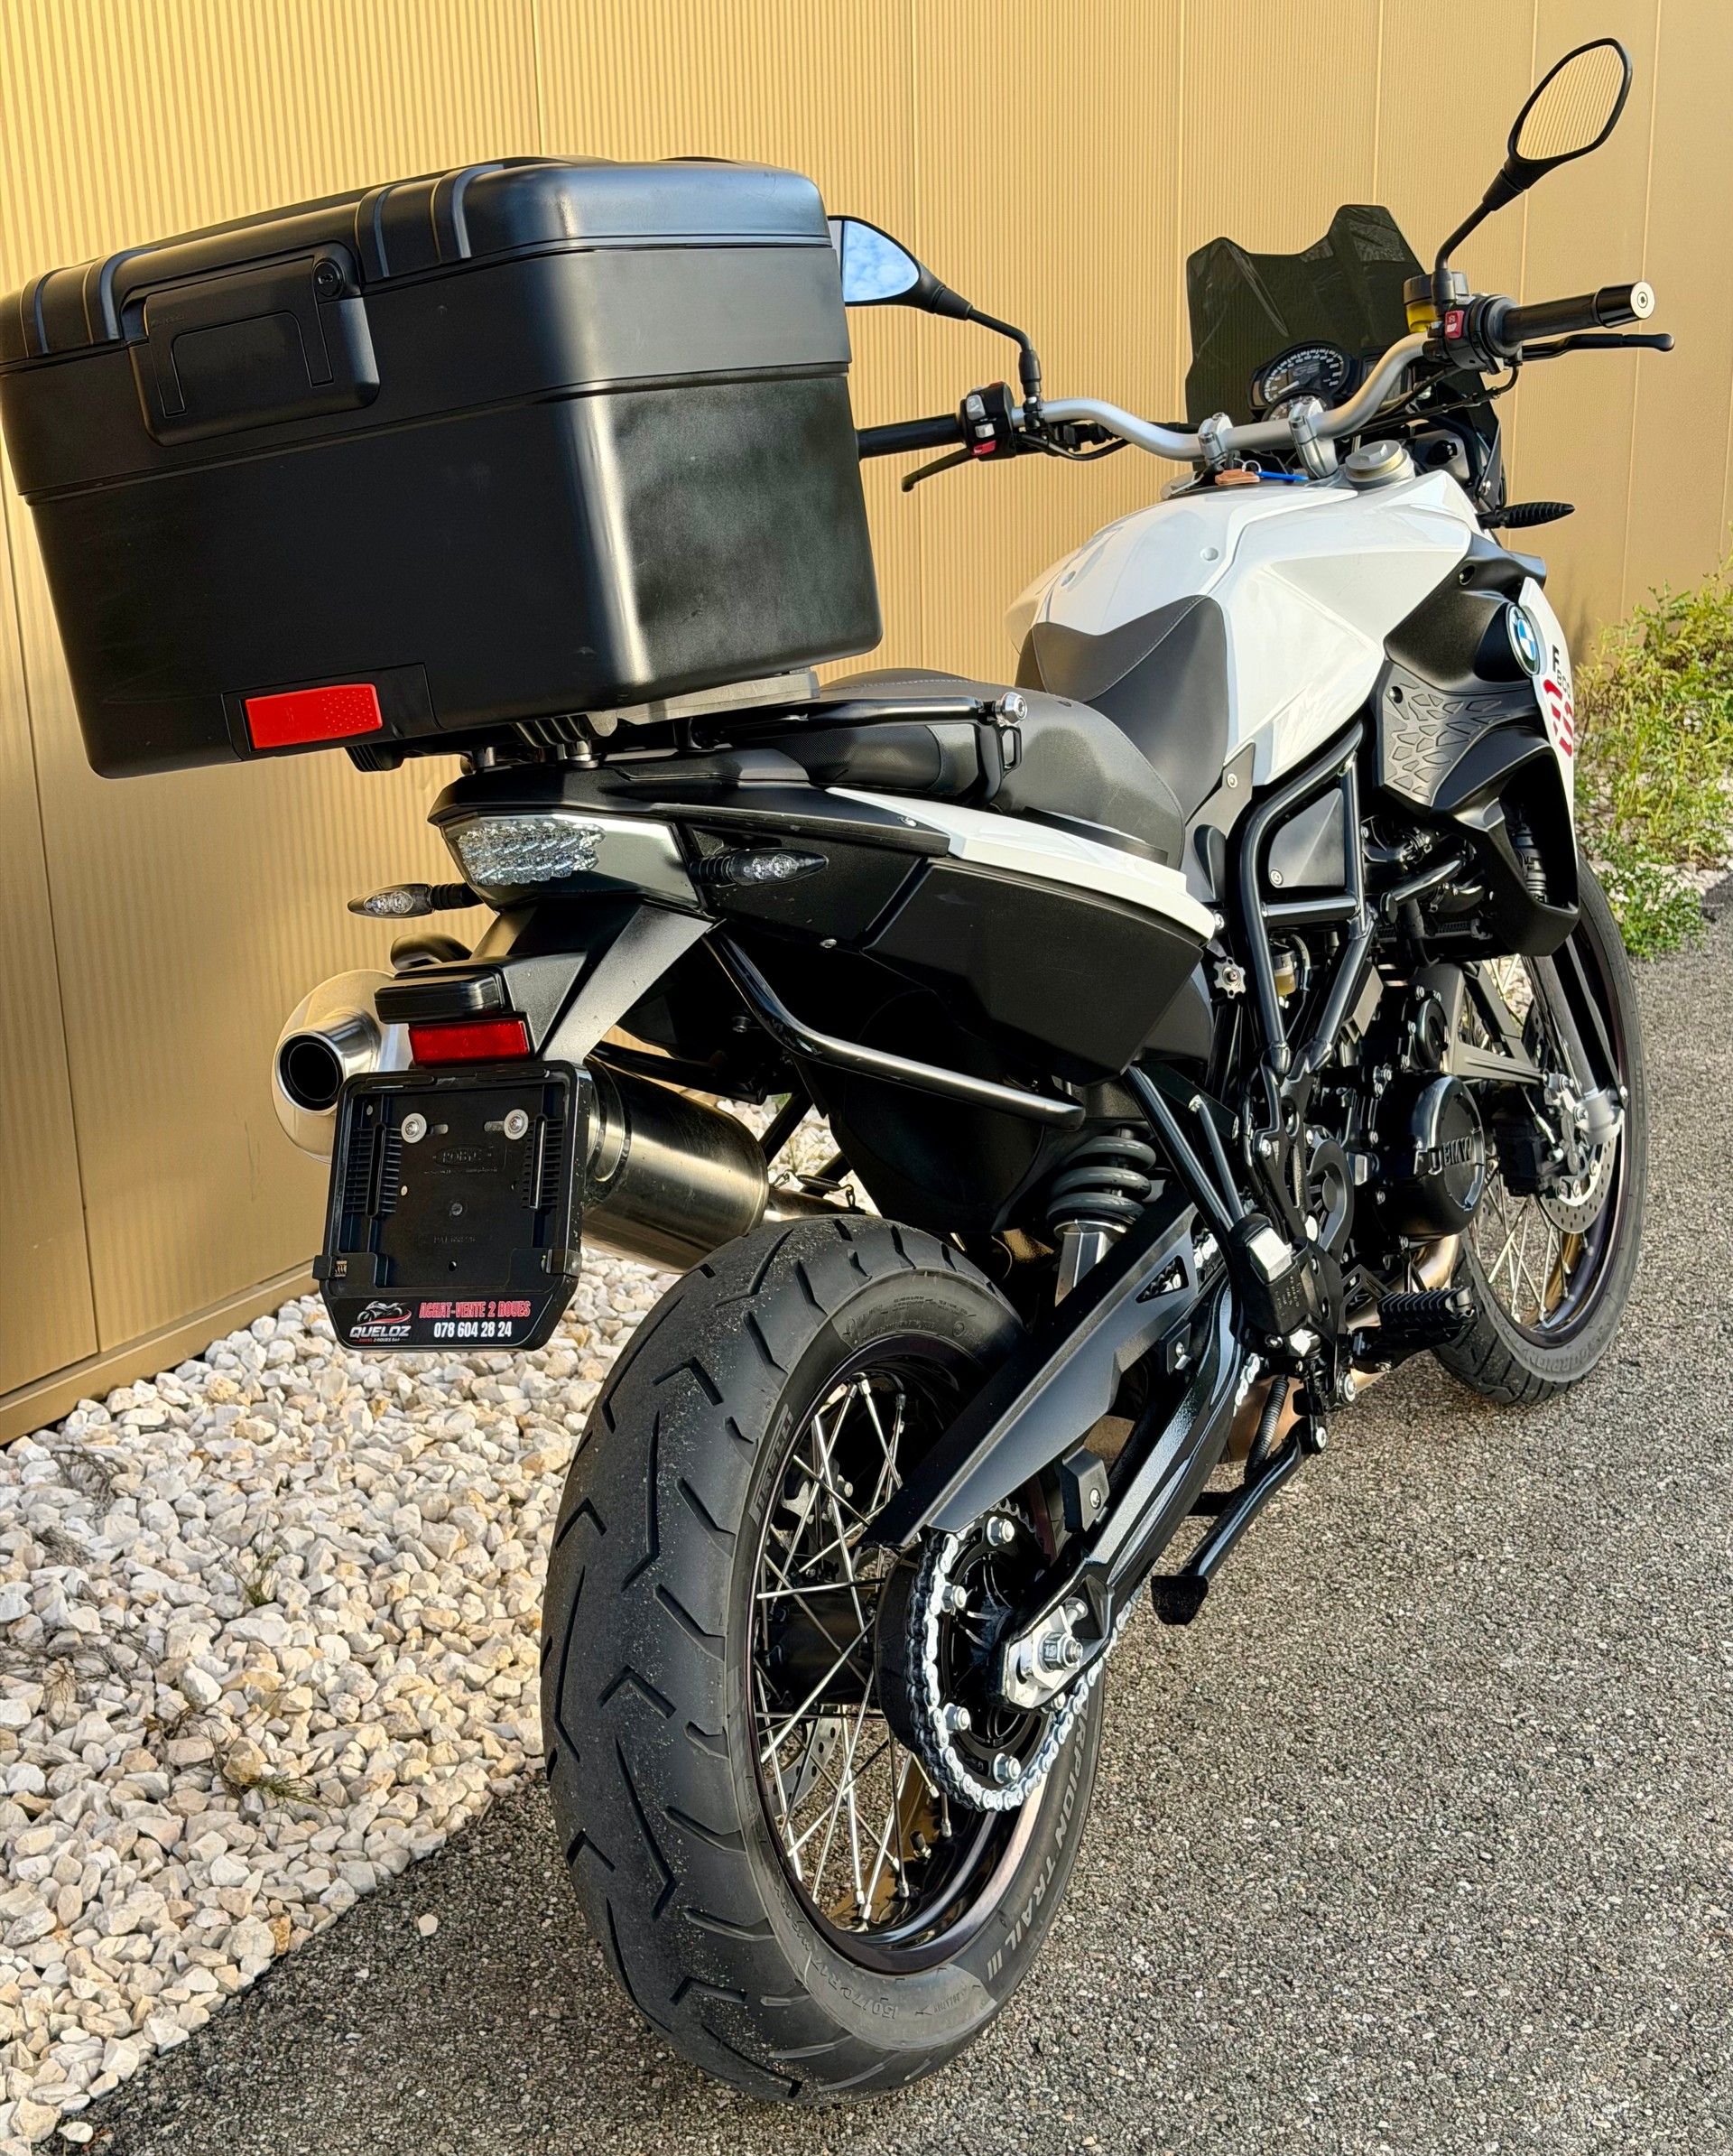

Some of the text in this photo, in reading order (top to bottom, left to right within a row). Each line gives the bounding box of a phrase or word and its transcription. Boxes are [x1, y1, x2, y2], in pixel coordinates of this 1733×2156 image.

[1552, 644, 1560, 673] F
[1441, 1136, 1472, 1167] BMW
[419, 1300, 532, 1318] ACHAT-VENTE 2 ROUES
[349, 1325, 412, 1338] QUELOZ
[433, 1321, 512, 1338] 078 604 28 24
[1005, 1855, 1057, 1951] TRAIL
[987, 1947, 1003, 1981] III
